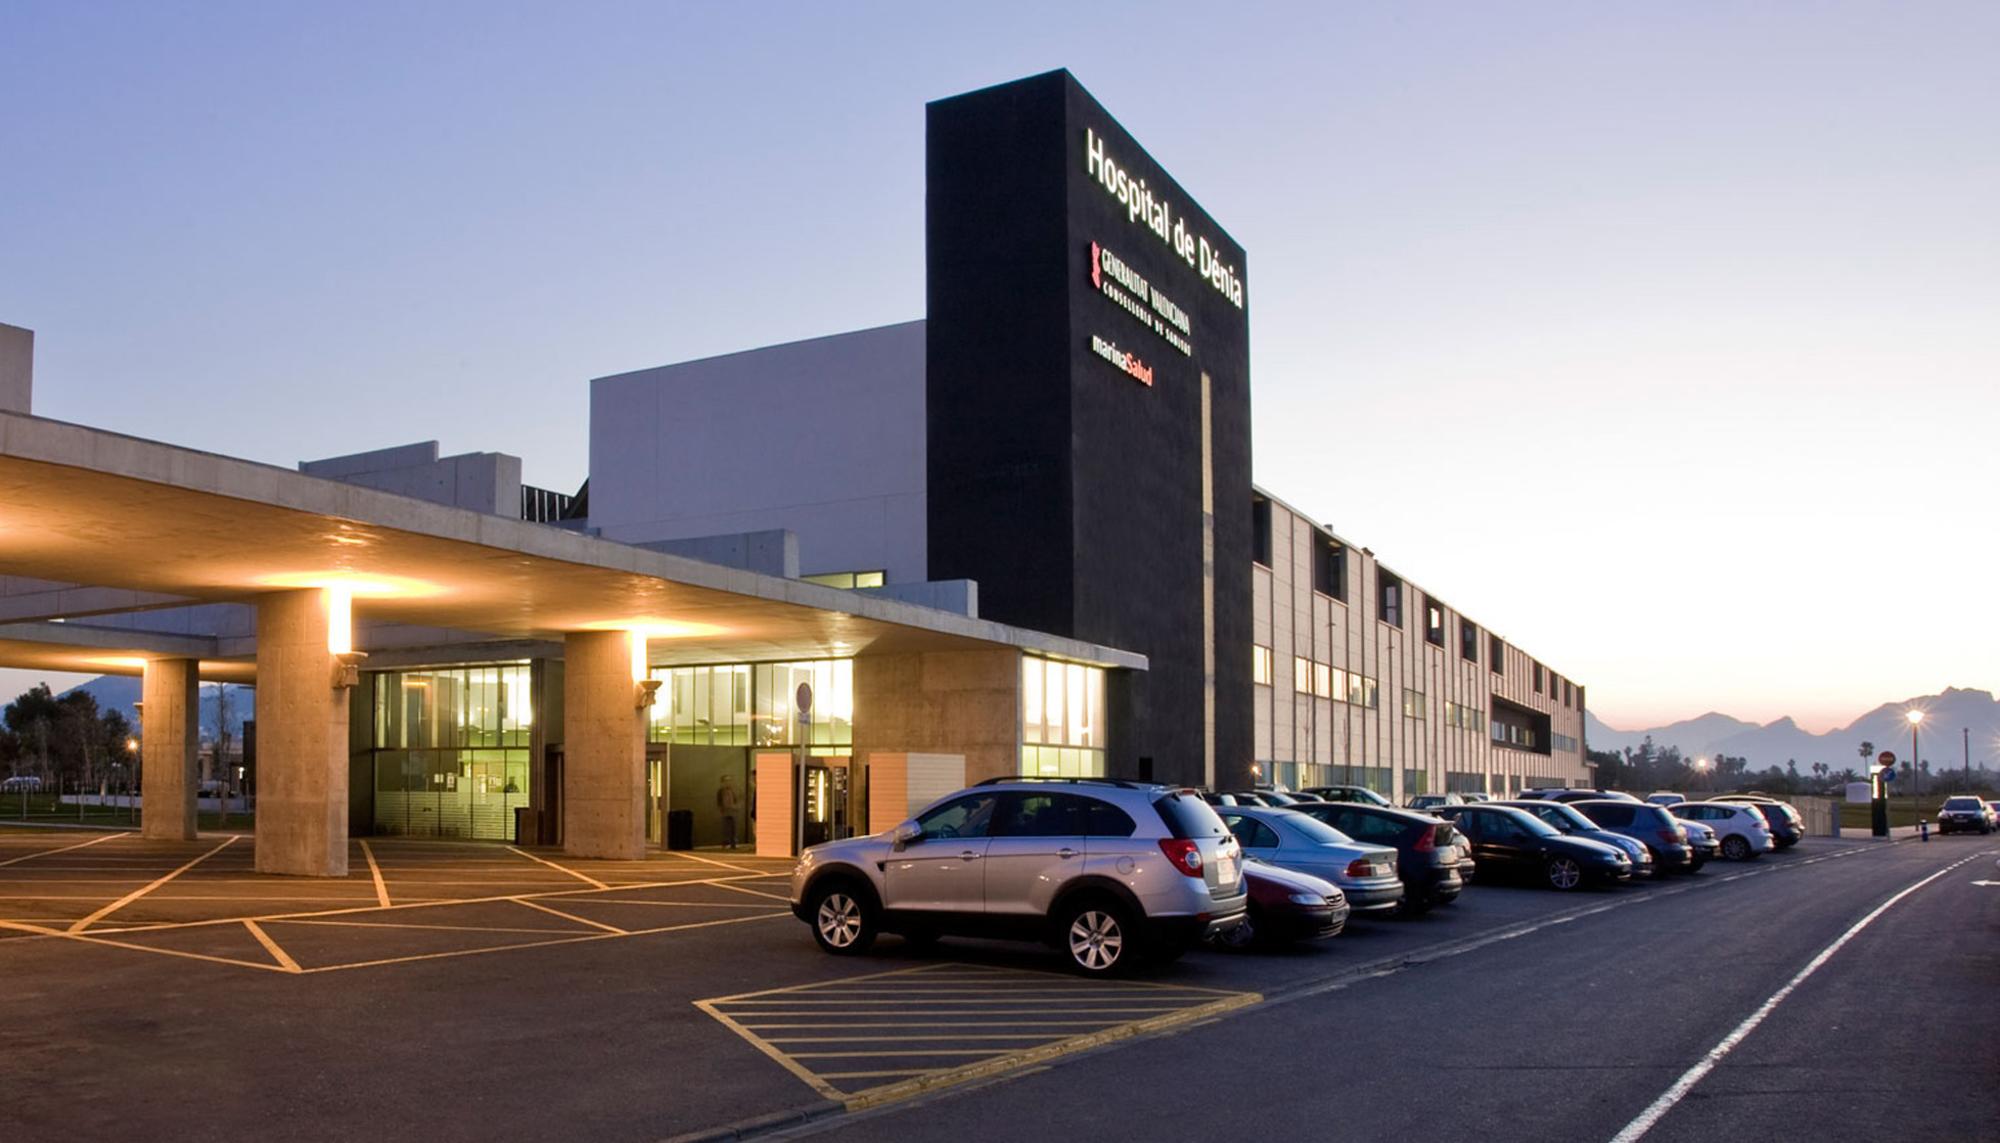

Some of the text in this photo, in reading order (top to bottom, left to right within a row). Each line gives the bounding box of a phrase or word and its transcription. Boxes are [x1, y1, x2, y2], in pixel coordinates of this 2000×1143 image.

[1087, 128, 1243, 310] Hospital de Dénia
[1102, 248, 1149, 303] GENERALITAT
[1092, 334, 1153, 387] marinaSalud
